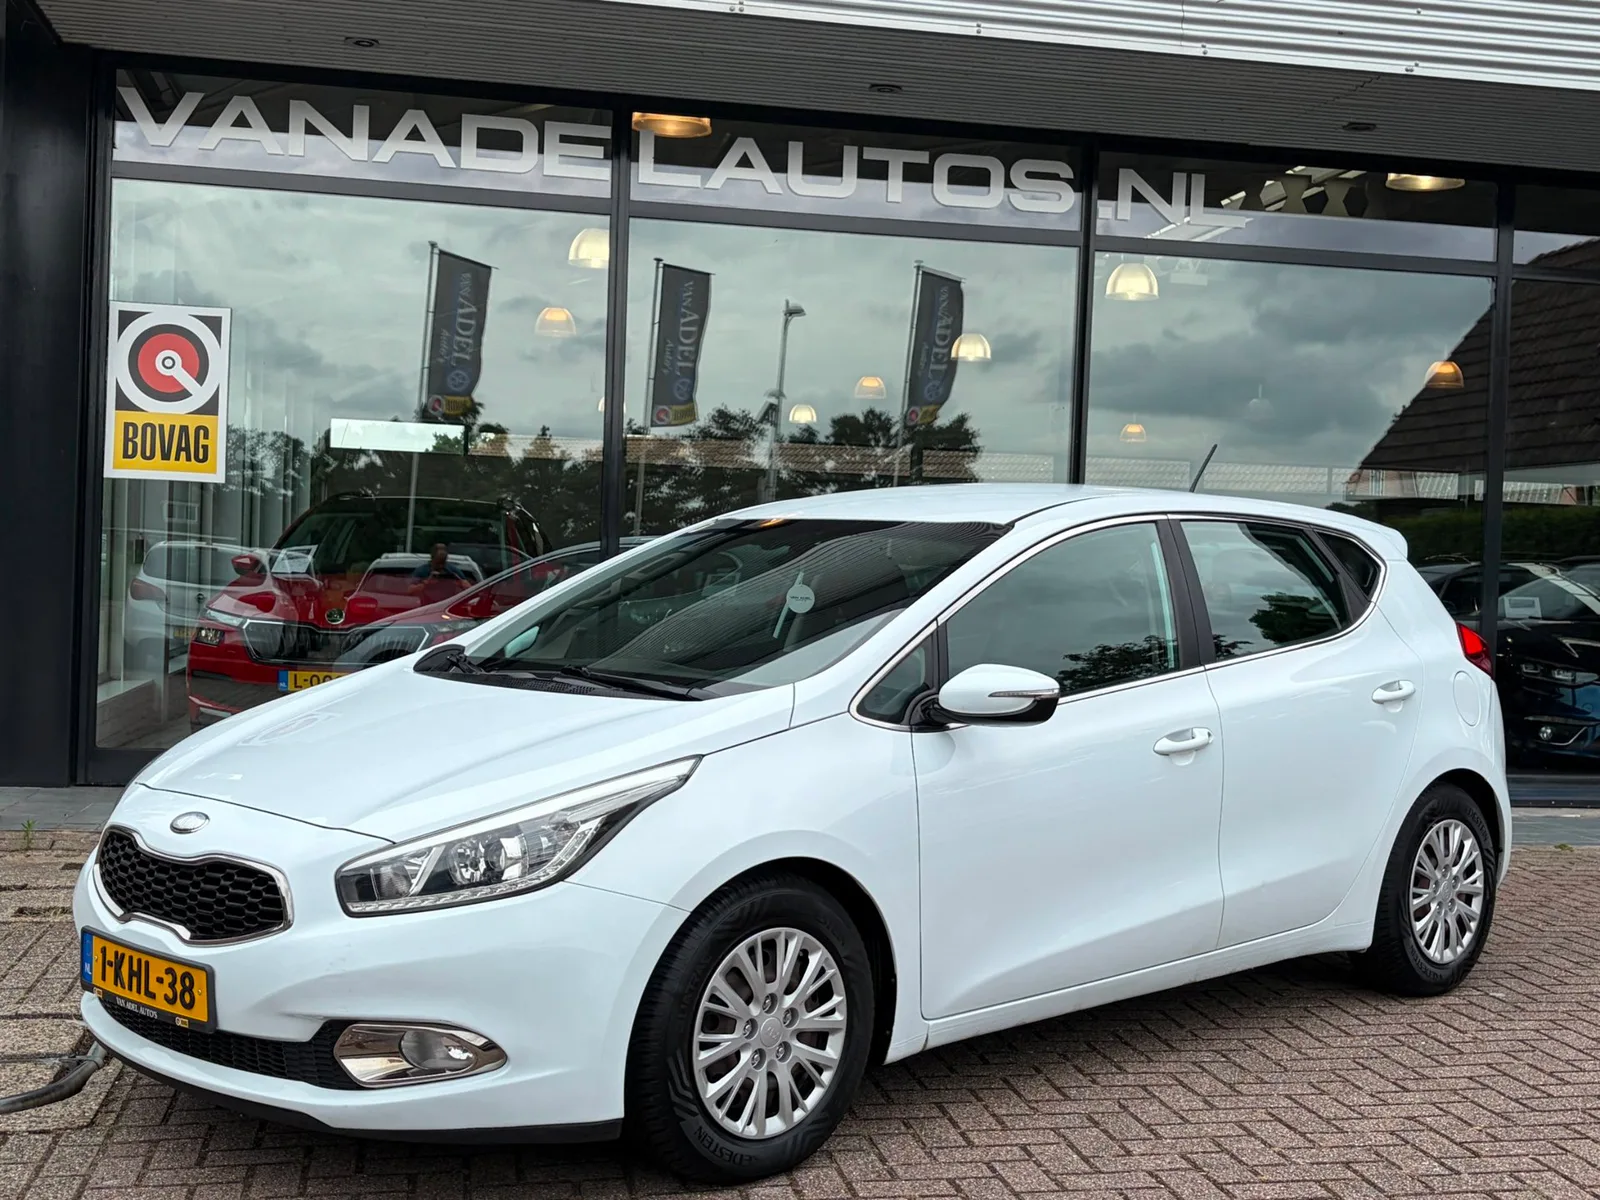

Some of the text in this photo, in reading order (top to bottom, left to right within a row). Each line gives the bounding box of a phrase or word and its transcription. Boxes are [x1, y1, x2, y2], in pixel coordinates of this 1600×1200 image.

[450, 297, 478, 367] ADEL
[674, 280, 700, 376] VAN ADEL
[927, 312, 953, 380] ADEL
[122, 421, 209, 463] BOVAG
[84, 945, 196, 1011] NL 1-KHL-38
[126, 1001, 138, 1013] ADEL
